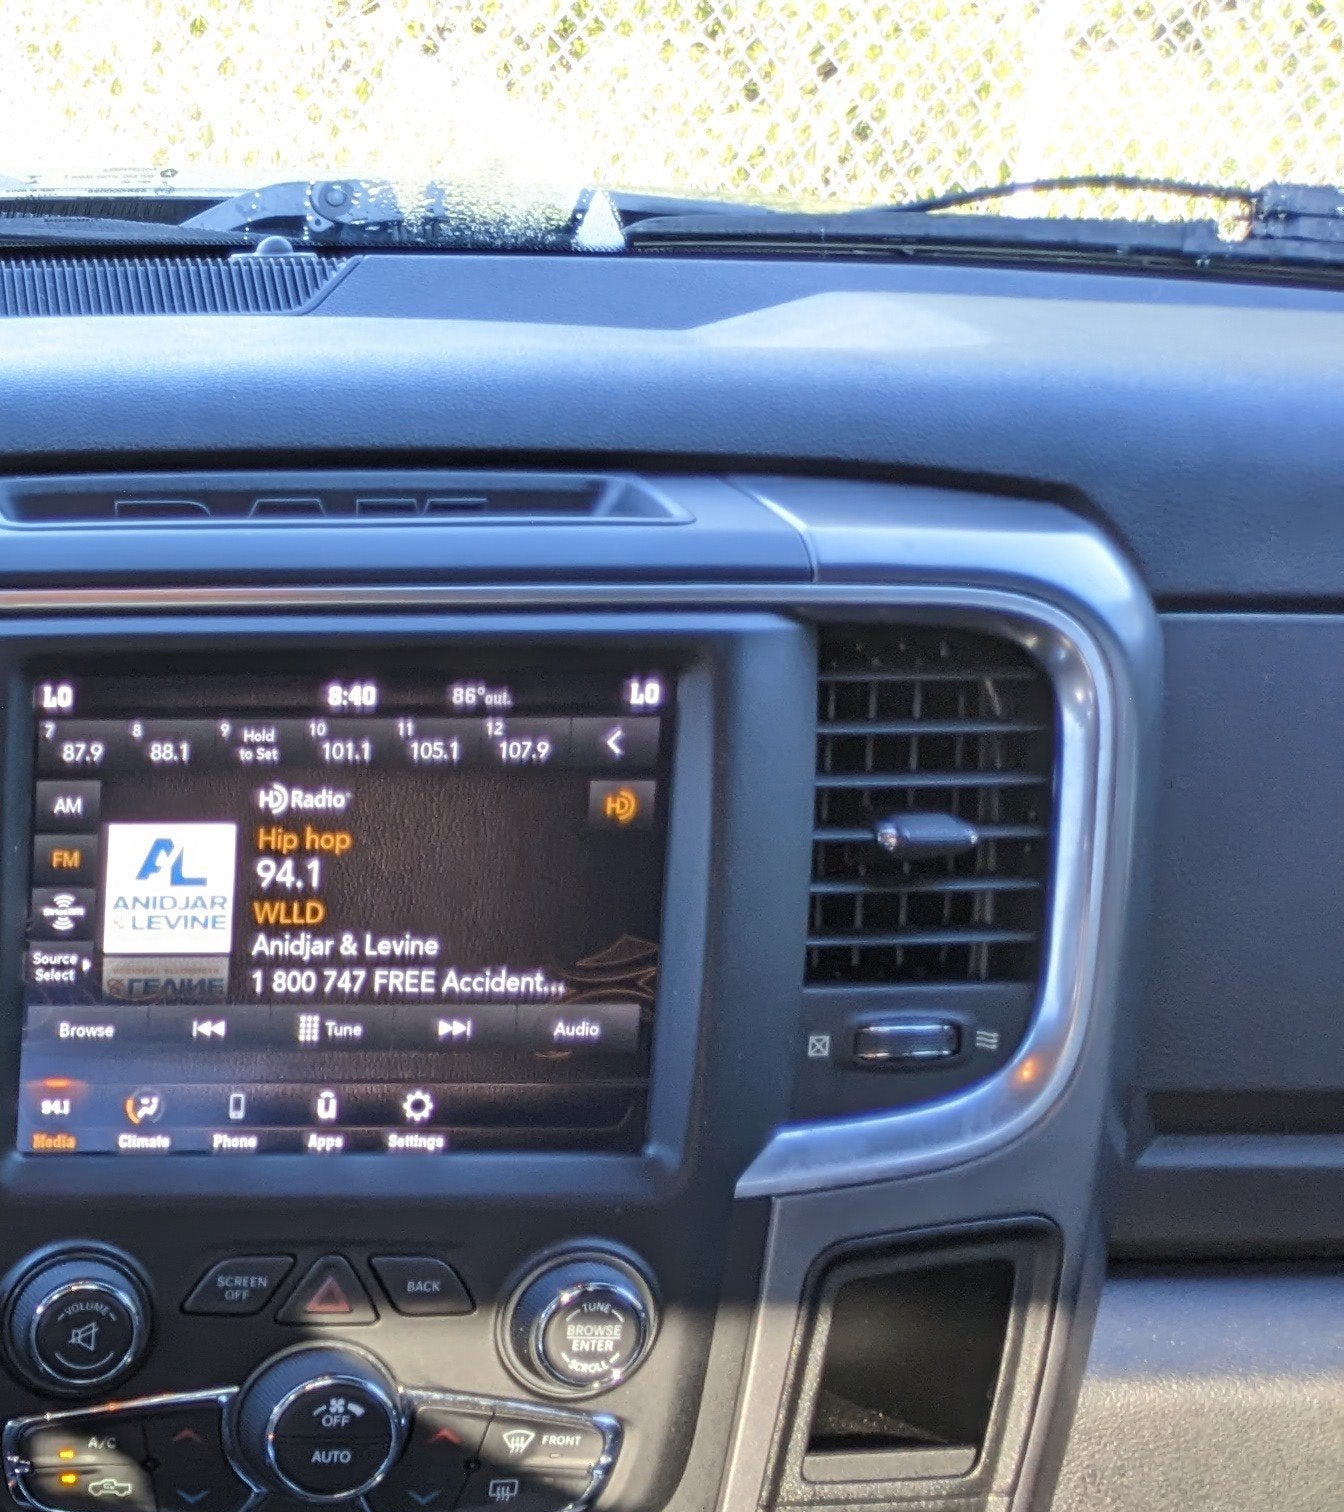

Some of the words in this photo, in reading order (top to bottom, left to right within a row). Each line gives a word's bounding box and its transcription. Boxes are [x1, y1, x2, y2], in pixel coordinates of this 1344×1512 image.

[327, 685, 377, 706] 8:40
[630, 682, 660, 706] LO
[45, 721, 57, 738] 7
[132, 722, 143, 738] 8
[220, 721, 231, 737] 9
[243, 728, 275, 742] Hold
[310, 721, 326, 737] 10
[398, 721, 413, 737] 11
[486, 721, 504, 737] 12
[62, 743, 104, 762] 87.9
[150, 743, 189, 762] 88.1
[239, 748, 253, 761] to
[256, 748, 280, 762] Set
[322, 742, 370, 760] 101.1
[411, 742, 459, 761] 105.1
[499, 742, 549, 760] 107.9
[53, 797, 82, 814] AM
[291, 789, 346, 808] Radio
[258, 827, 298, 854] Hip
[305, 825, 352, 856] hop
[52, 851, 80, 869] FM
[256, 859, 320, 889] 94.1
[113, 895, 227, 911] ANIDJAR
[253, 901, 327, 925] WLLD
[131, 915, 226, 930] LEVINE
[252, 932, 334, 961] Anidjar
[340, 933, 358, 957] &
[365, 933, 439, 957] Levine
[32, 952, 78, 966] Source
[34, 968, 75, 982] Select
[252, 971, 263, 993] 1
[272, 970, 316, 994] 800
[324, 970, 366, 994] 747
[374, 970, 436, 993] FREE
[59, 1022, 114, 1039] Browse
[326, 1021, 362, 1037] Tune
[554, 1020, 599, 1038] Audio
[32, 1134, 76, 1150] Media
[118, 1134, 170, 1149] Climate
[213, 1134, 257, 1149] Phone
[308, 1134, 343, 1151] Apps
[388, 1134, 444, 1151] Settings
[216, 1275, 268, 1288] SCREEN
[407, 1280, 441, 1293] BACK
[224, 1289, 251, 1302] OFF
[64, 1301, 111, 1318] VOLUME
[581, 1302, 613, 1314] TUNE
[566, 1323, 622, 1338] BROWSE
[571, 1338, 614, 1352] ENTER
[568, 1358, 610, 1374] SCROLL
[321, 1414, 351, 1428] OFF
[87, 1435, 117, 1450] A/C
[541, 1434, 582, 1447] FRONT
[311, 1450, 352, 1464] AUTO
